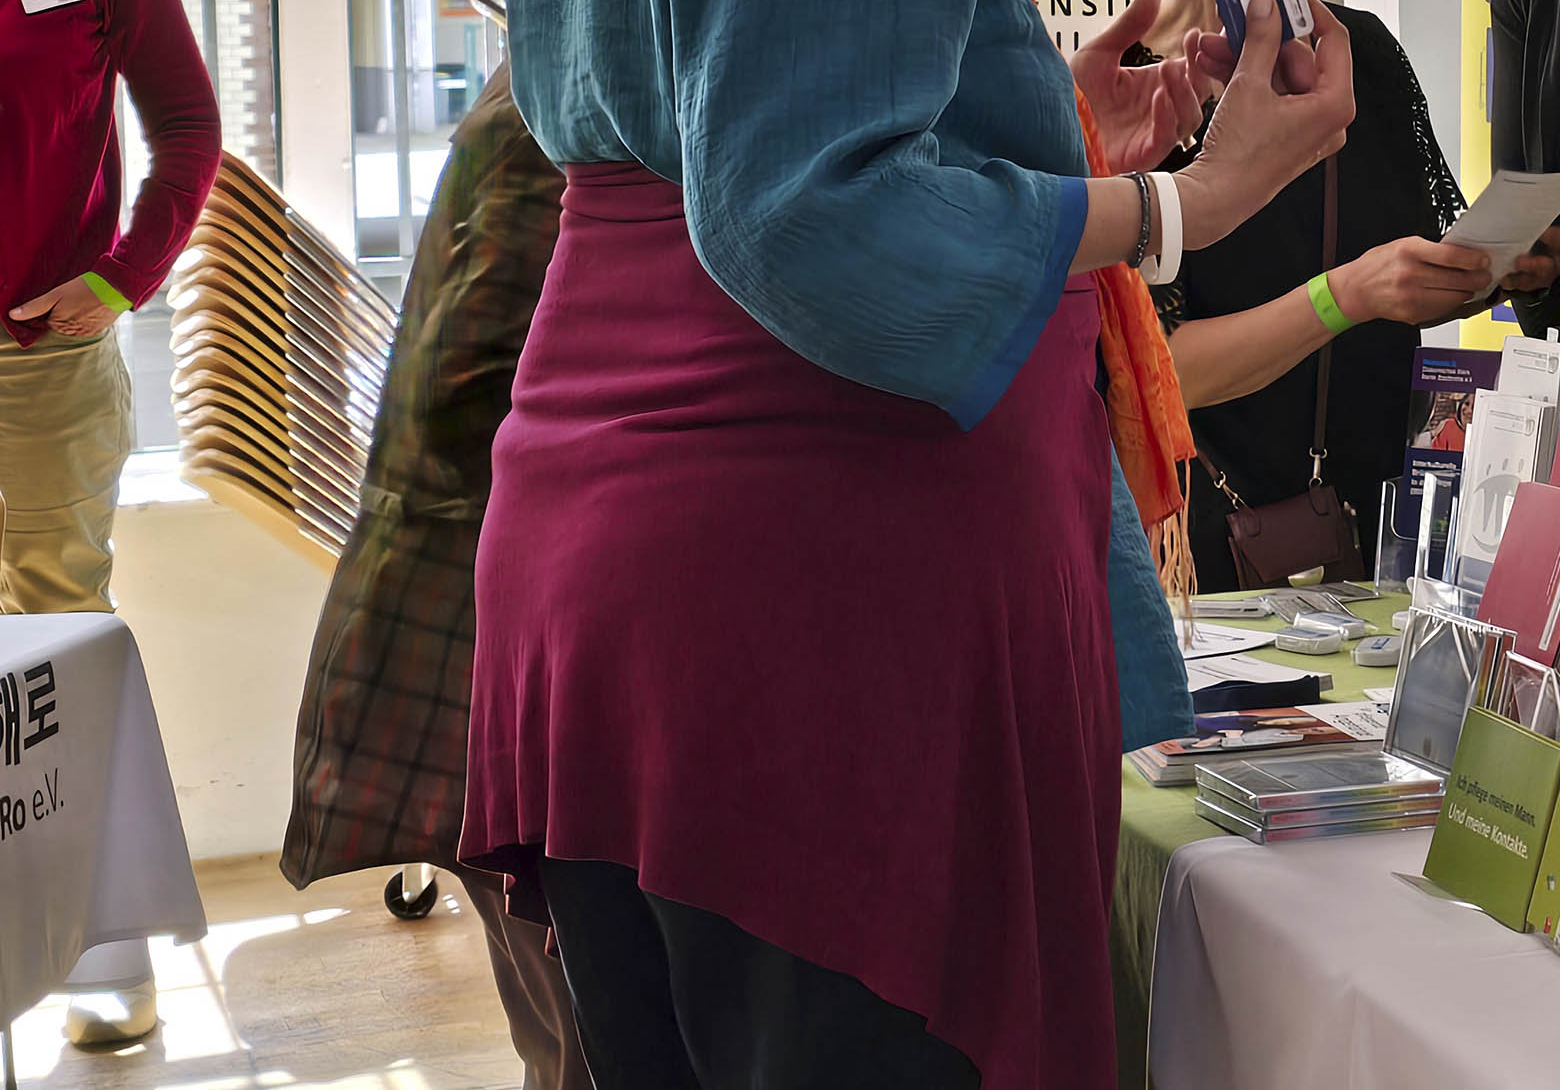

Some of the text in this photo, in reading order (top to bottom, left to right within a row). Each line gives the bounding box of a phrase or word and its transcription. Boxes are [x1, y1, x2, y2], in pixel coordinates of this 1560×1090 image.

[33, 767, 64, 821] e.V.
[1448, 802, 1528, 860] Und meine Kontakte.
